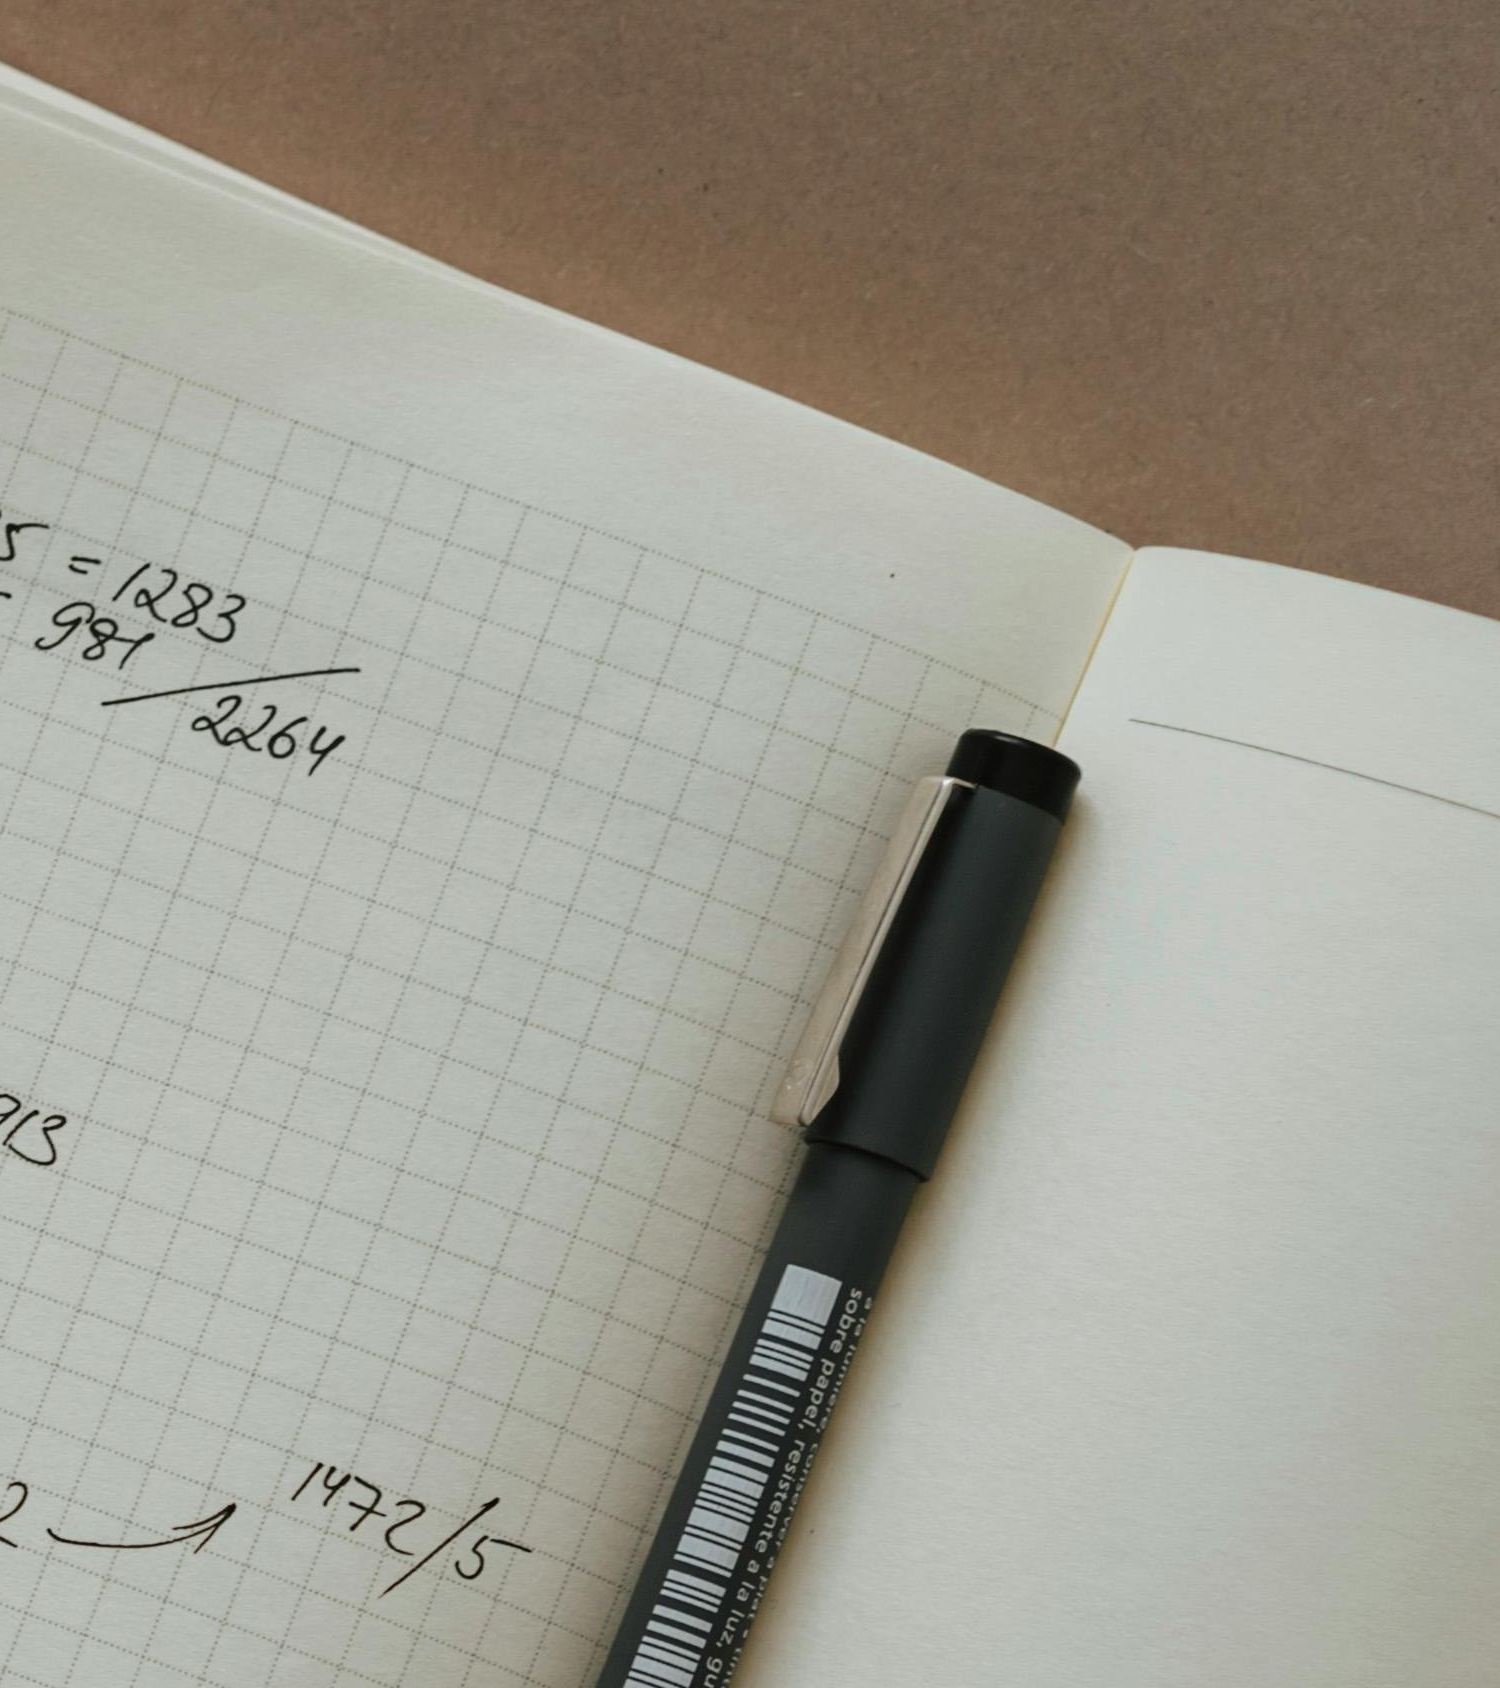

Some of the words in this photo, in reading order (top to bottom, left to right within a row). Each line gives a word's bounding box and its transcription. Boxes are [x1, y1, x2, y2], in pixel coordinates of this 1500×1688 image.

[34, 603, 154, 670] 981
[111, 564, 248, 645] 1283
[191, 695, 346, 776] 2264
[826, 1287, 866, 1356] sobre
[793, 1357, 839, 1434] papel,
[749, 1438, 810, 1554] resistente
[734, 1580, 756, 1604] la
[745, 1558, 761, 1574] a
[715, 1608, 745, 1652] luz,
